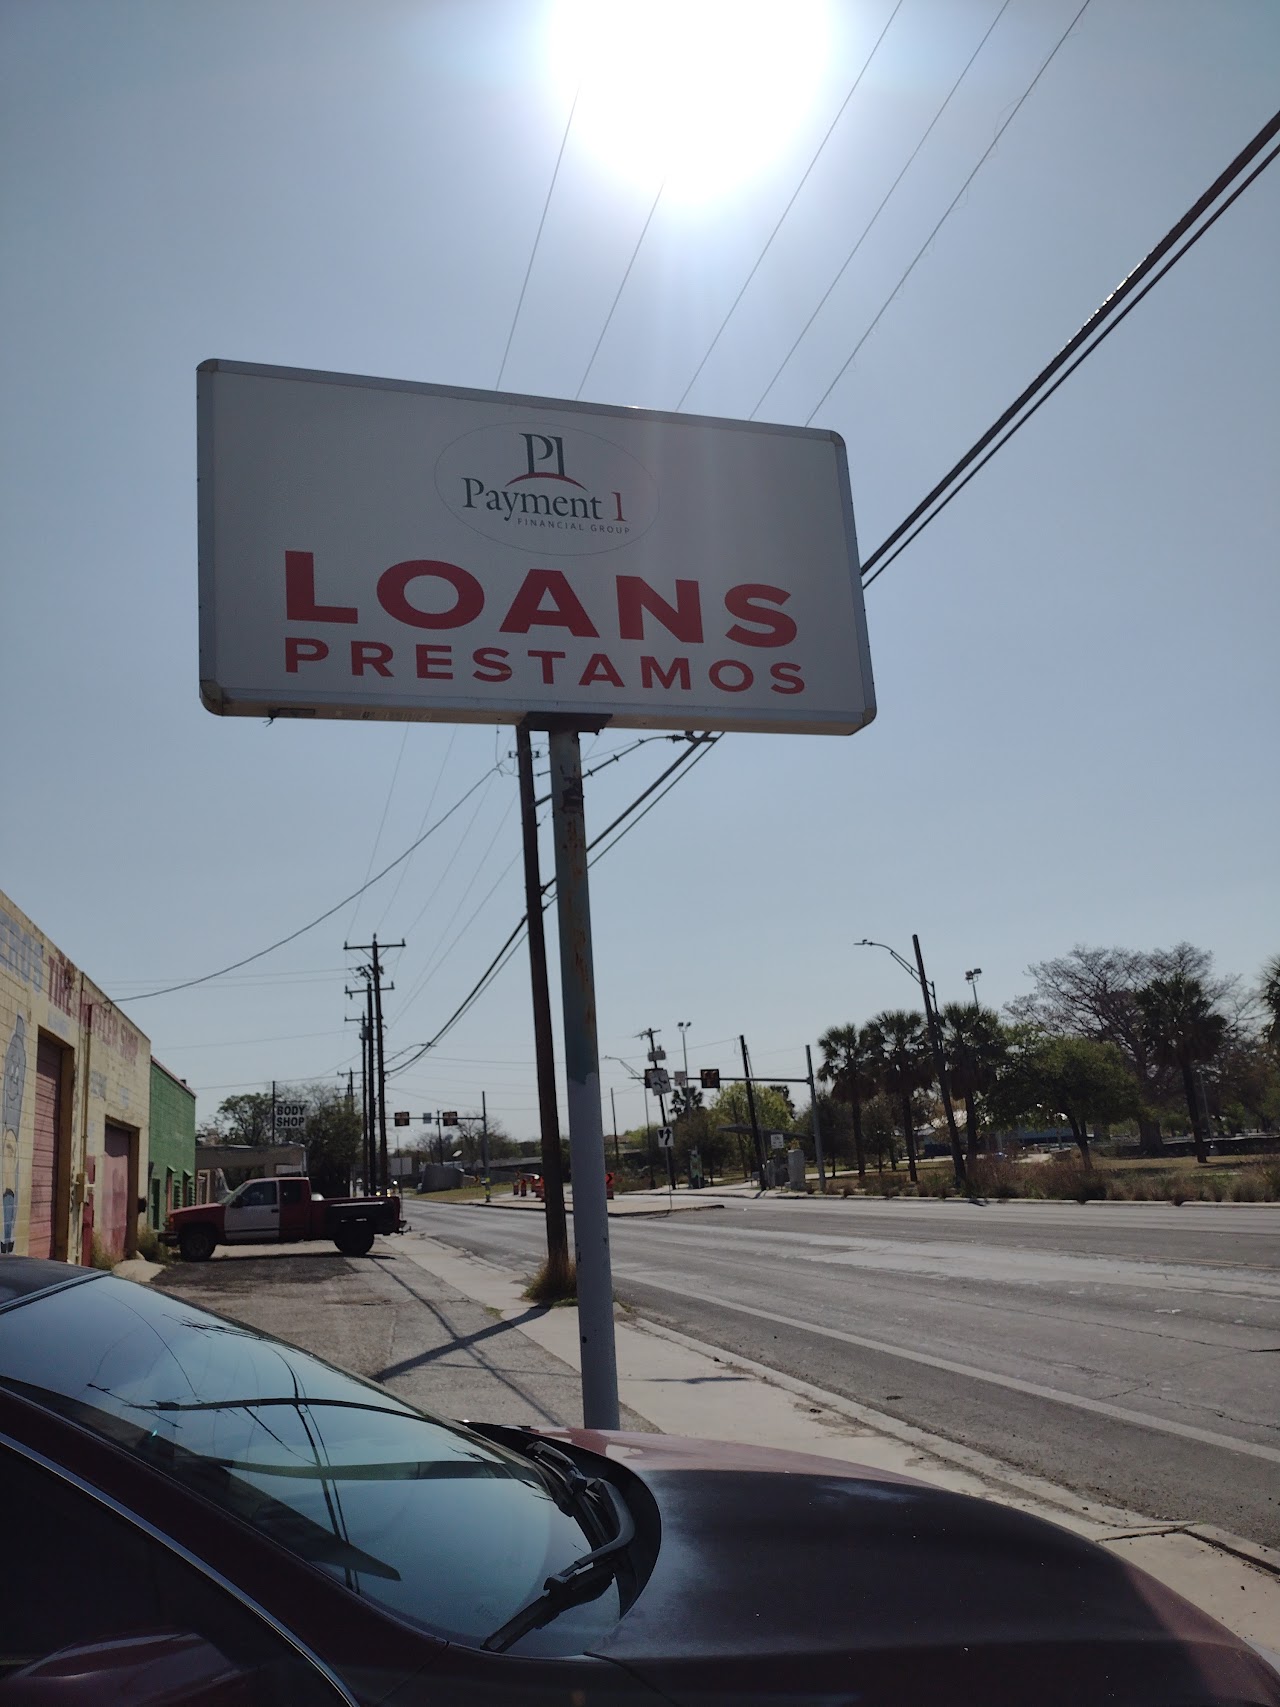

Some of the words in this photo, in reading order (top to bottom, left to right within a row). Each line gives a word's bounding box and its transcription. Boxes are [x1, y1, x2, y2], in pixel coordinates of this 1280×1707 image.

[461, 477, 604, 521] Payment
[612, 491, 628, 522] 1
[517, 518, 585, 531] FINANCIAL
[590, 524, 631, 535] GROUP
[285, 550, 798, 648] LOANS
[285, 637, 805, 695] PRESTAMOS
[276, 1106, 305, 1115] BODY
[276, 1117, 305, 1127] SHOP
